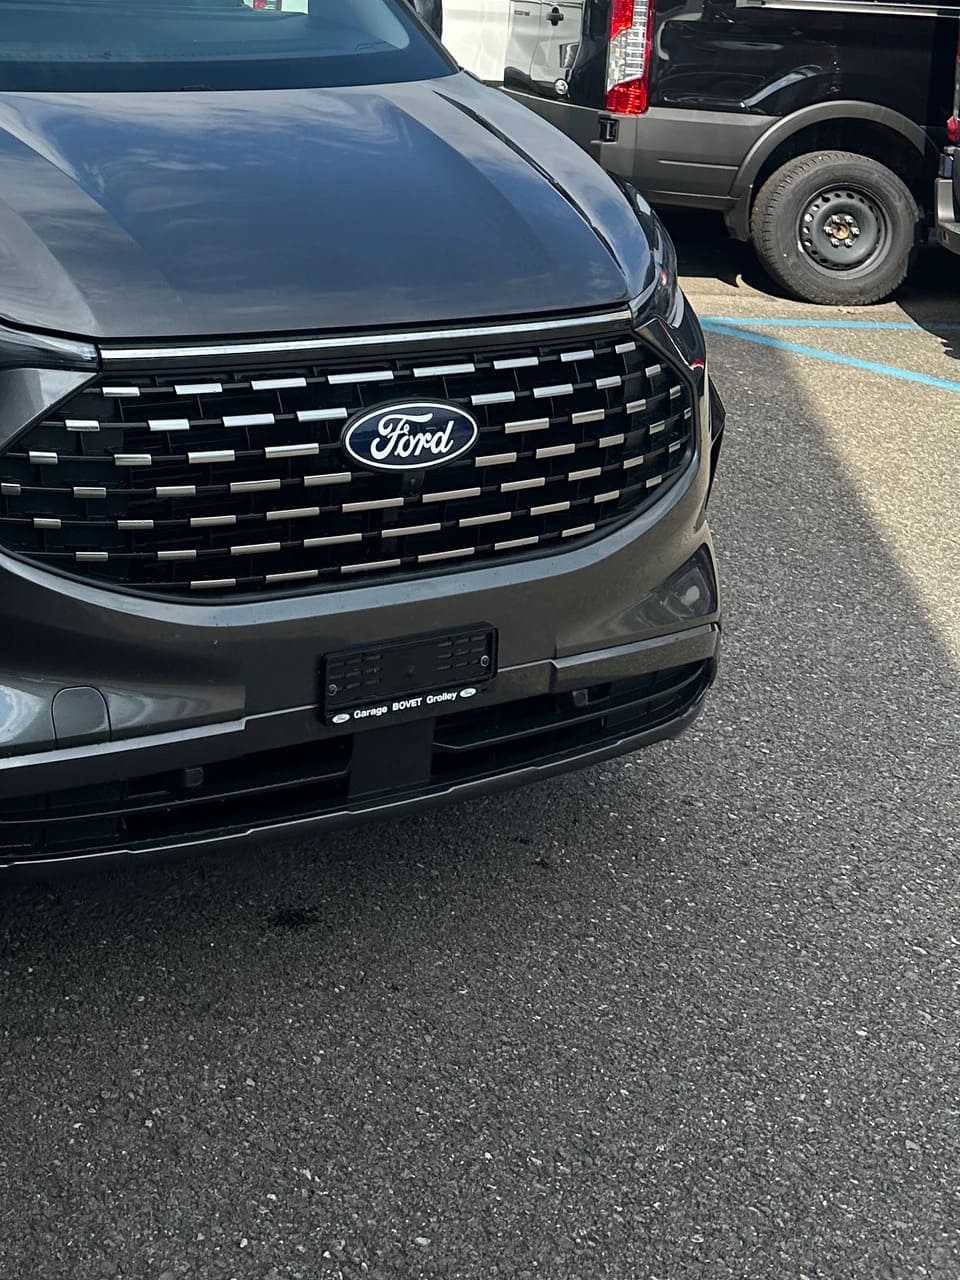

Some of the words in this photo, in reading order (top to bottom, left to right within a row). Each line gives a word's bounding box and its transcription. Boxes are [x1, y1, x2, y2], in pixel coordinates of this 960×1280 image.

[370, 412, 455, 460] Ford
[353, 705, 388, 719] Garage
[392, 697, 423, 711] BOVET
[426, 691, 458, 704] Grolley
